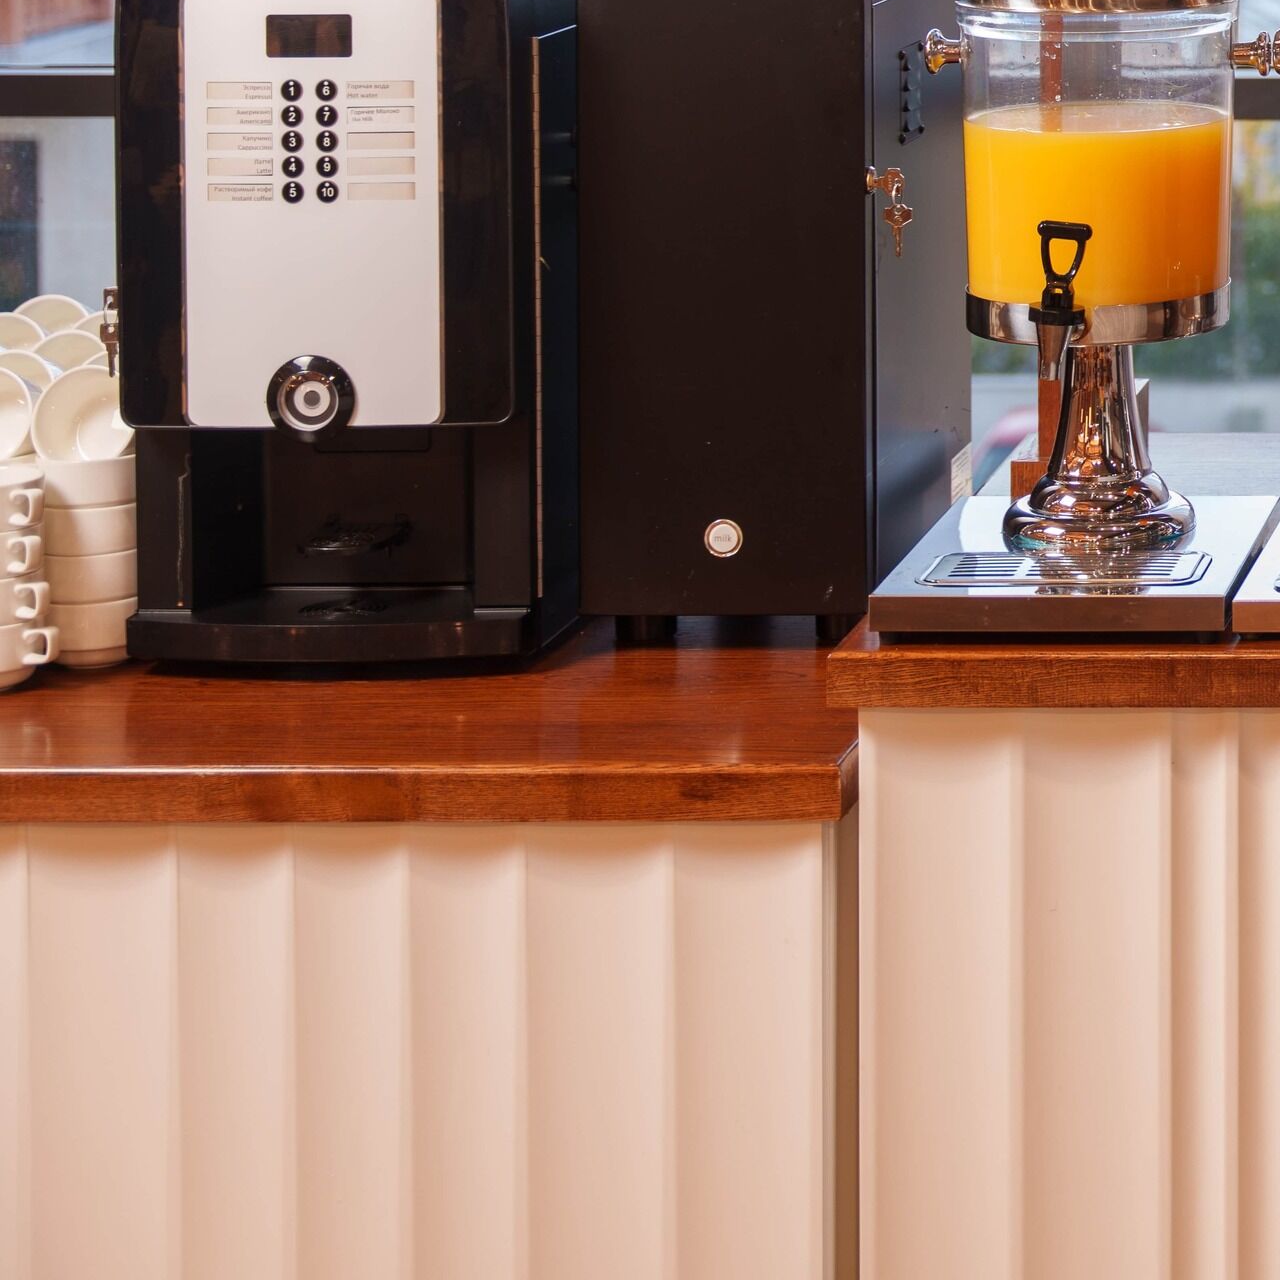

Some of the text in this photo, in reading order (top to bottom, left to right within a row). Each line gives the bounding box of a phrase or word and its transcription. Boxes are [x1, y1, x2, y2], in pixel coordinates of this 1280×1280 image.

[289, 86, 294, 96] 1
[322, 86, 330, 96] 6
[288, 112, 296, 122] 2
[323, 112, 330, 121] 7
[289, 137, 296, 147] 3
[323, 137, 331, 147] 8
[289, 163, 296, 172] 4
[323, 162, 331, 172] 9
[289, 187, 296, 197] 5
[321, 188, 334, 197] 10
